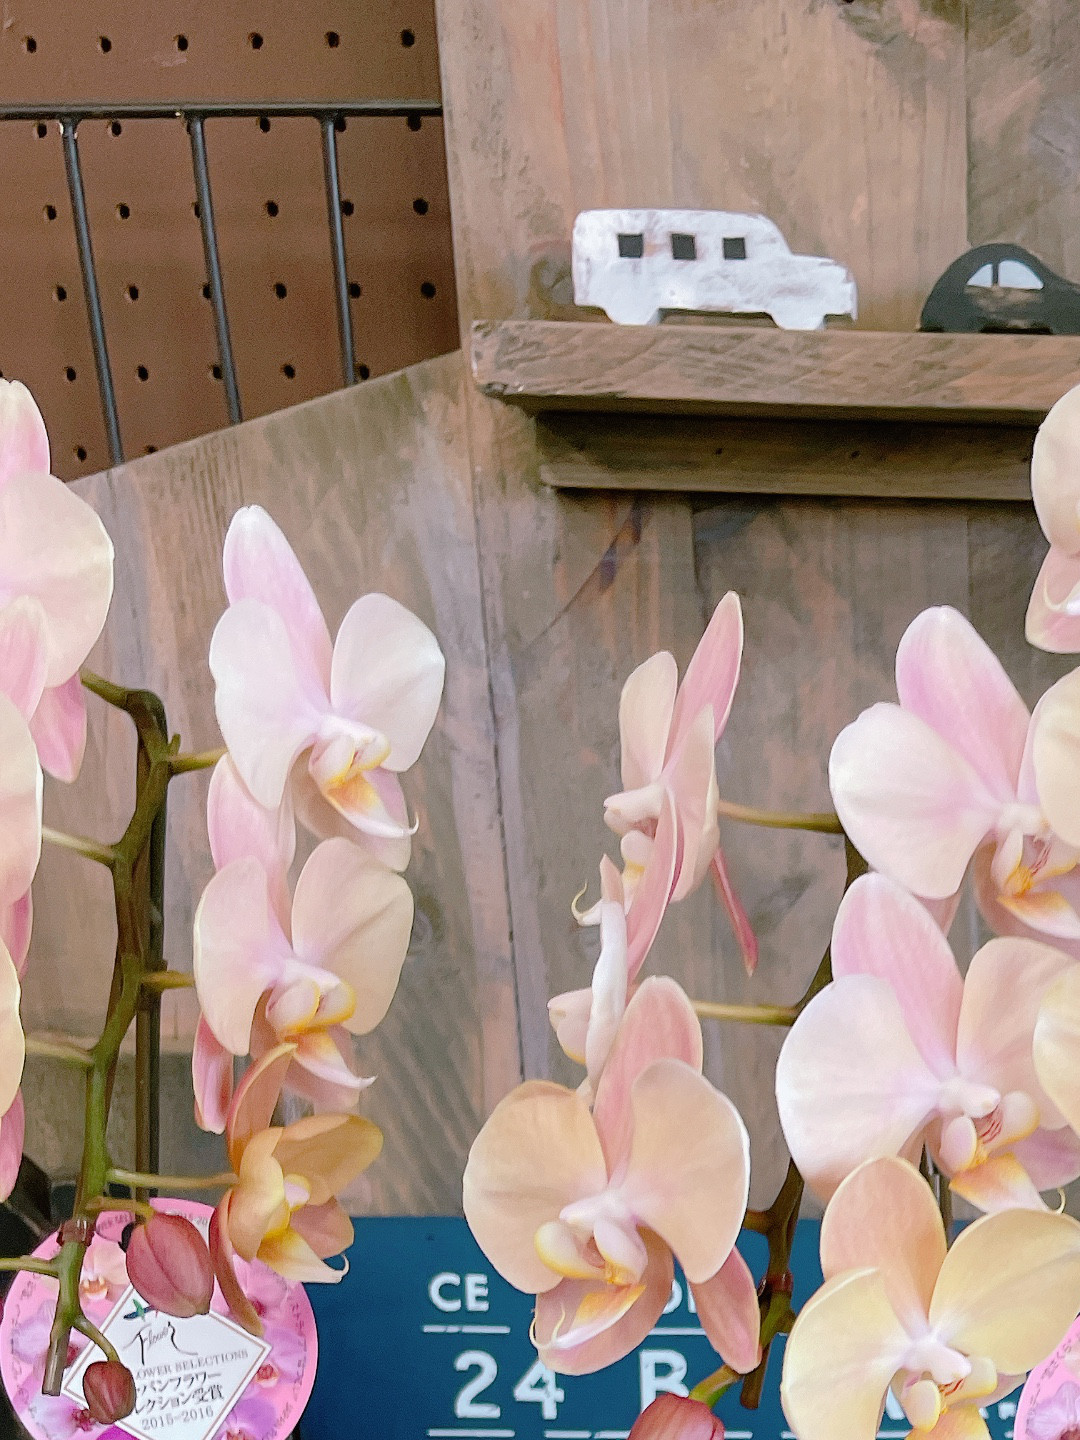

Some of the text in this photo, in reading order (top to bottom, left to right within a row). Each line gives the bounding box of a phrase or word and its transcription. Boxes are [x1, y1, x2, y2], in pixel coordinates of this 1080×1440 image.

[428, 1271, 490, 1313] CE
[453, 1349, 566, 1421] 24
[141, 1405, 215, 1431] 2015-2016
